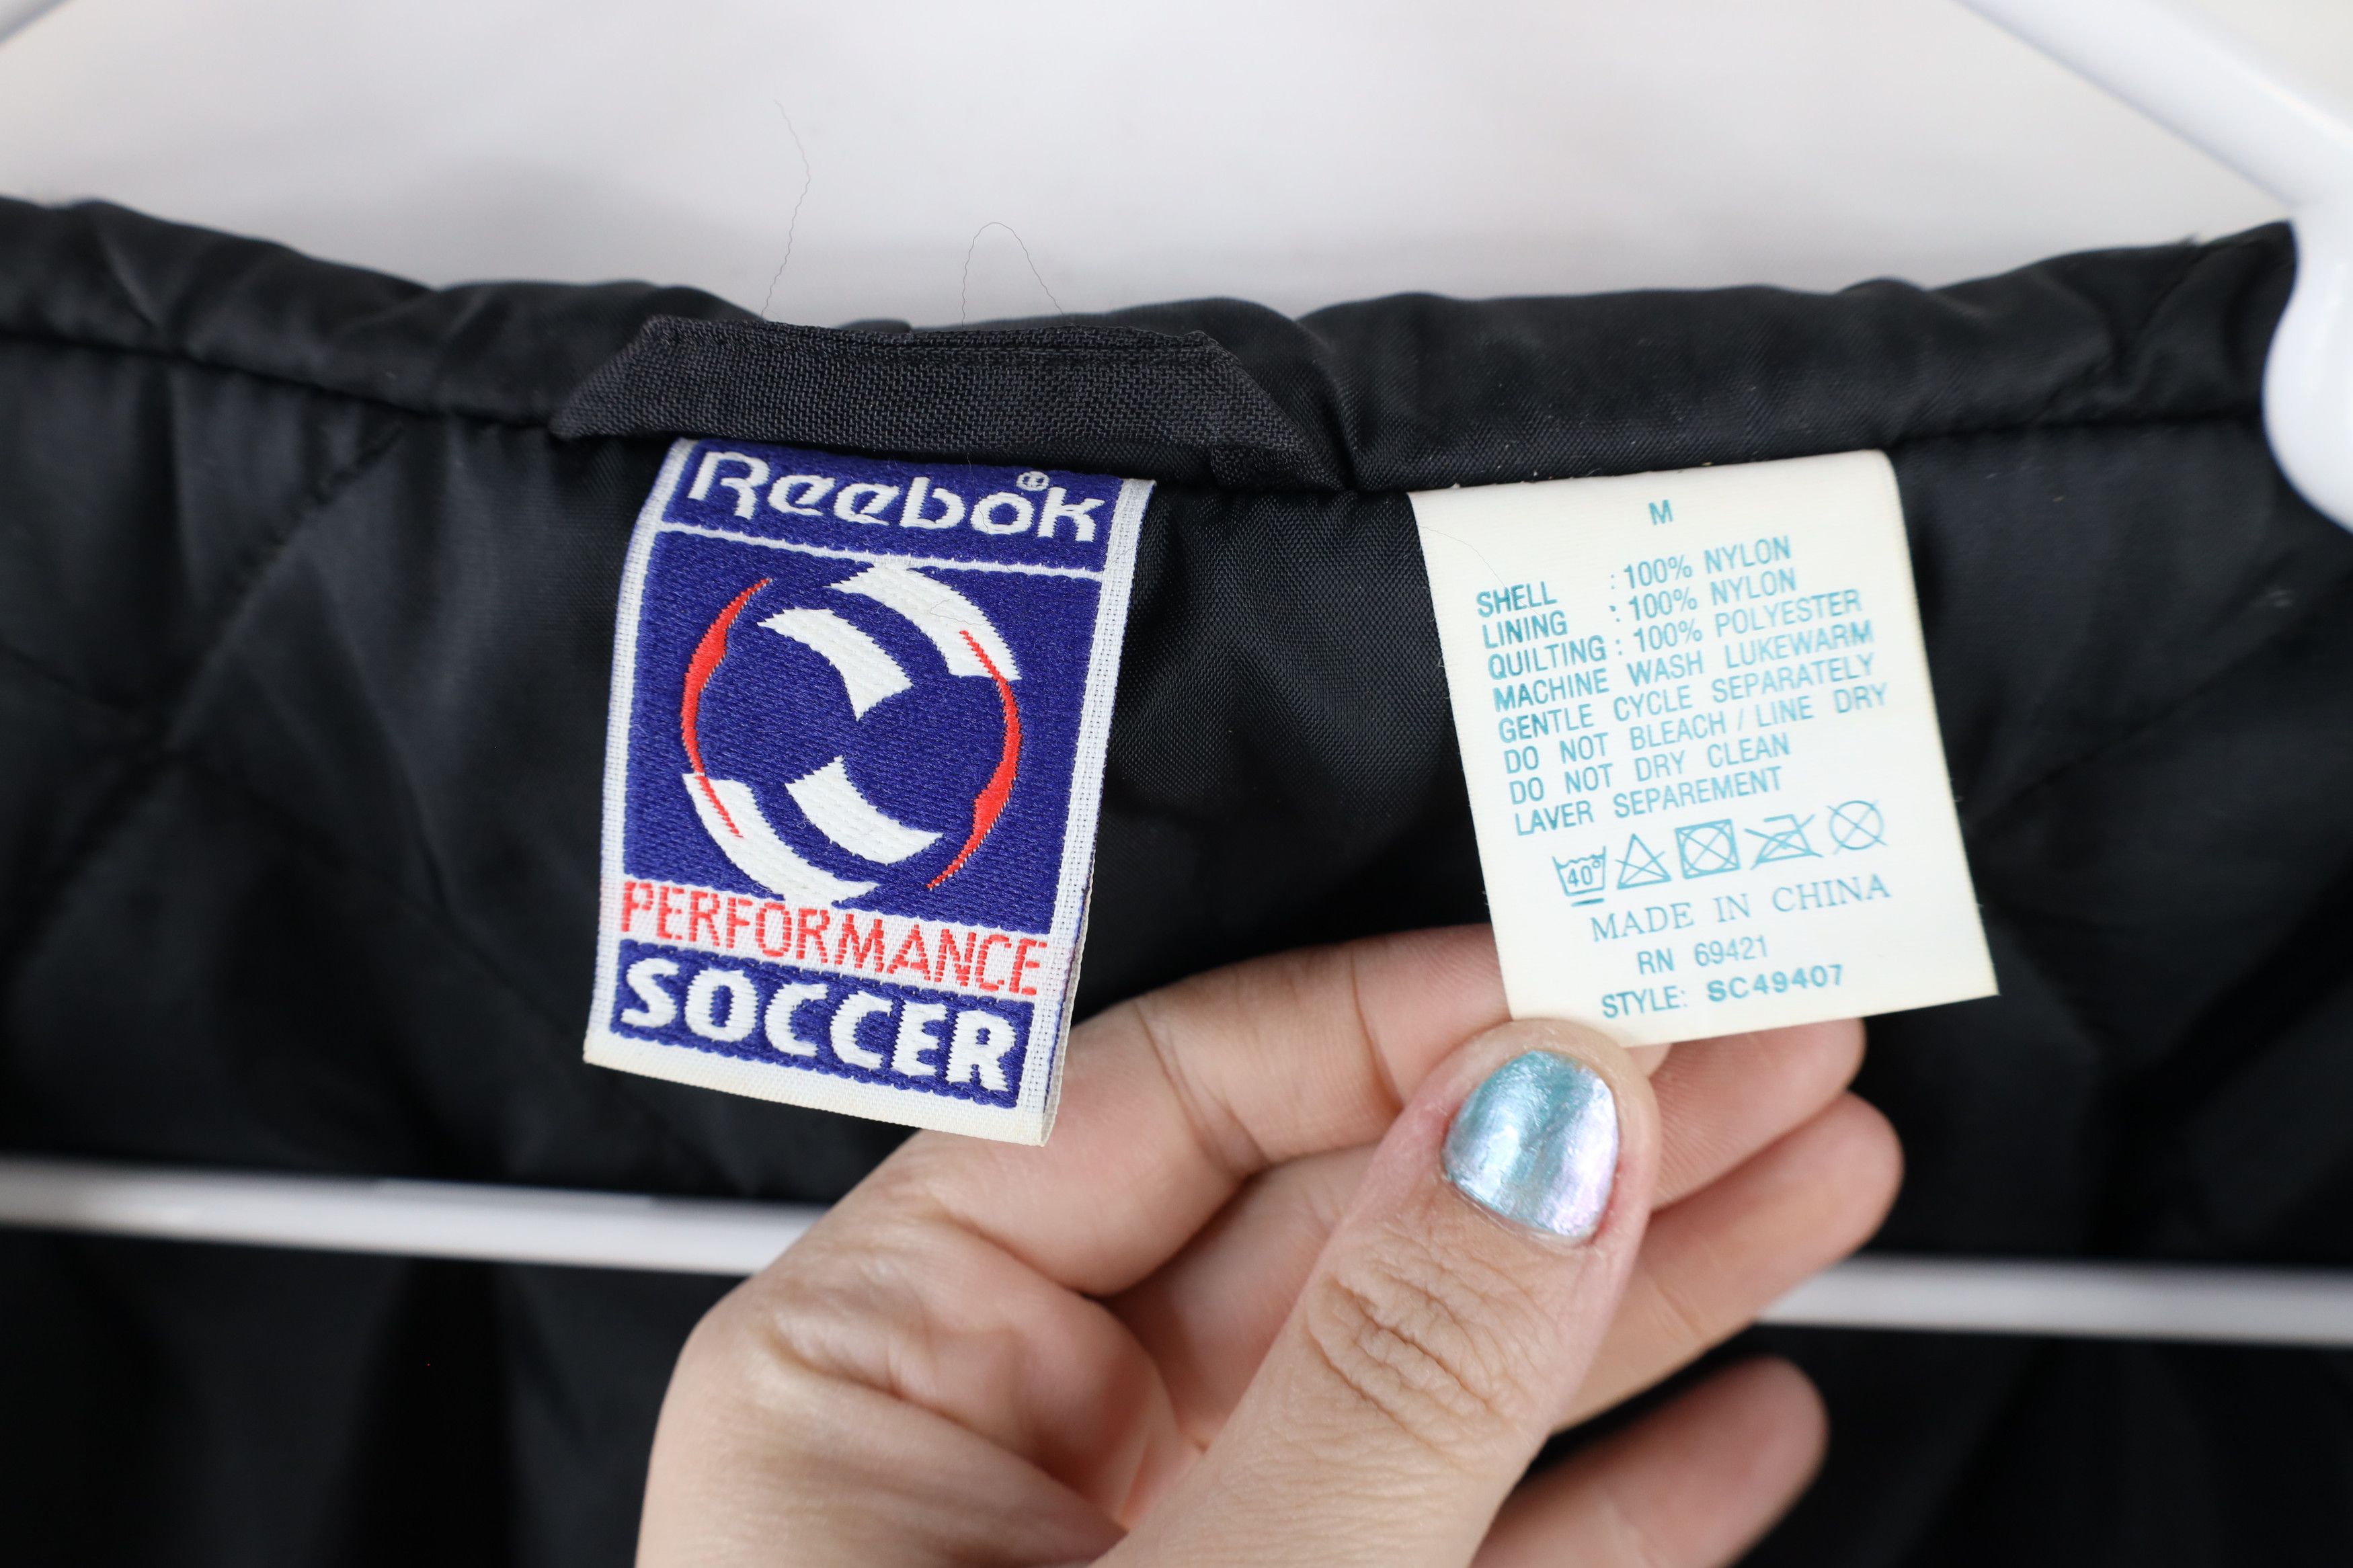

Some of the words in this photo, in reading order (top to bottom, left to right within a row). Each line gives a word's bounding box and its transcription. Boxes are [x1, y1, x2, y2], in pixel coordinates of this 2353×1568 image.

[687, 451, 1108, 542] Reebok
[1648, 500, 1673, 525] M
[1476, 581, 1558, 618] SHELL
[1704, 536, 1792, 573] NYLON
[1482, 610, 1568, 649] LINING
[1710, 568, 1796, 606] NYLON
[1488, 634, 1607, 679] QUILTING
[1715, 589, 1862, 637] POLYESTER
[1492, 667, 1609, 712] MACHINE
[1627, 650, 1704, 687] WASH
[1725, 620, 1874, 668] LUKEWARM
[1499, 703, 1594, 743] GENTLE
[1613, 685, 1693, 721] CYCLE
[1712, 652, 1874, 703] SEPARATELY
[1504, 745, 1540, 774] DO
[1560, 732, 1608, 764] NOT
[1833, 682, 1887, 714] DRY
[1509, 777, 1544, 805] DO
[1564, 763, 1613, 794] NOT
[1635, 750, 1685, 782] DRY
[1708, 732, 1790, 768] CLEAN
[1515, 800, 1594, 836] LAVER
[1613, 766, 1782, 818] SEPAREMENT
[620, 880, 1048, 996] PERFORMANCE
[1591, 902, 1694, 942] MADE
[1713, 893, 1751, 922] IN
[1773, 873, 1892, 912] CHINA
[1602, 985, 1687, 1018] STYLE:
[1707, 964, 1843, 1002] SC49407
[1637, 948, 1675, 975] RN
[1694, 935, 1767, 966] 69421
[621, 957, 1016, 1094] SOCCER
